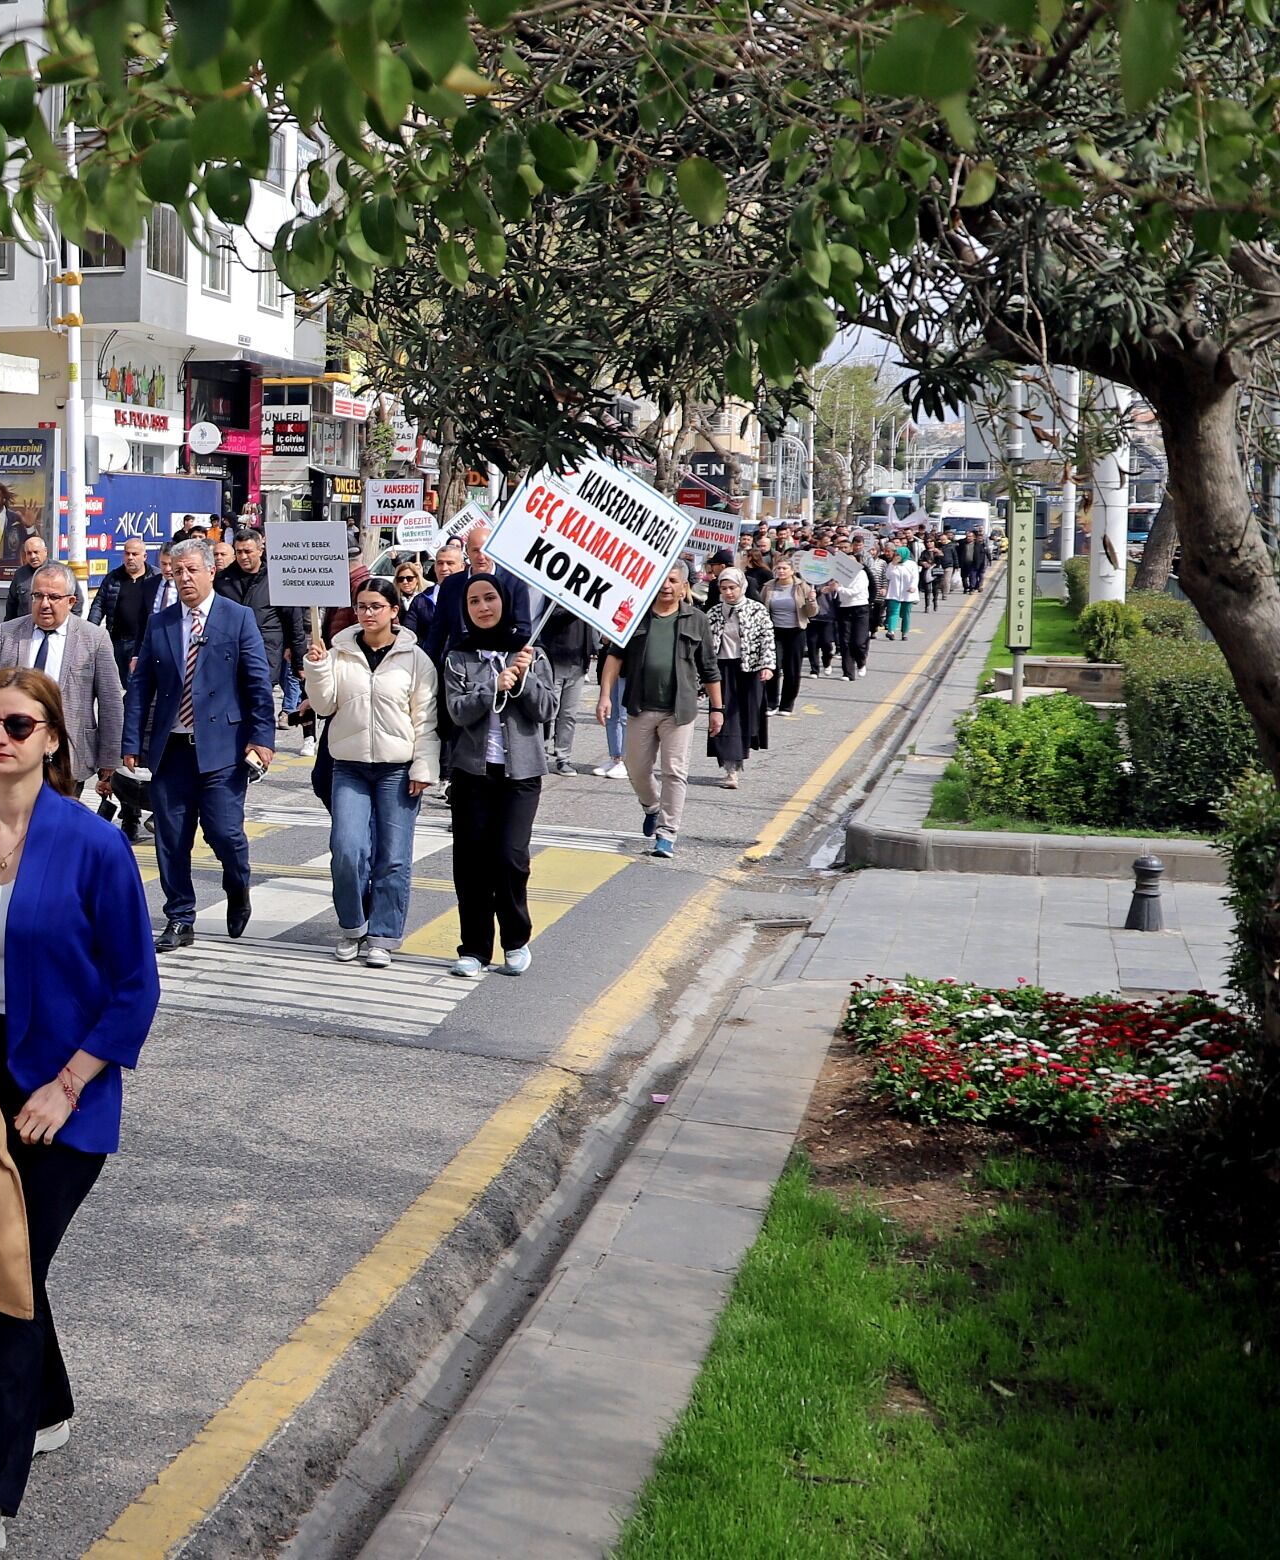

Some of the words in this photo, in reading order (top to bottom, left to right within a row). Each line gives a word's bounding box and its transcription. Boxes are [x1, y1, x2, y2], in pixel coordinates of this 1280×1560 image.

[384, 482, 419, 494] KANSERSİZ
[376, 499, 415, 511] YAŞAM
[576, 470, 651, 536] KANSERDEN
[641, 511, 679, 557] DEĞİL
[115, 511, 164, 541] AKÇAL
[404, 516, 432, 526] OBEZİTE
[446, 511, 474, 536] KANSERE
[699, 515, 735, 531] KANSERDEN
[525, 485, 564, 534] GEÇ
[556, 505, 656, 590] KALMAKTAN
[282, 565, 296, 573] BAĞ
[524, 535, 613, 610] KORK
